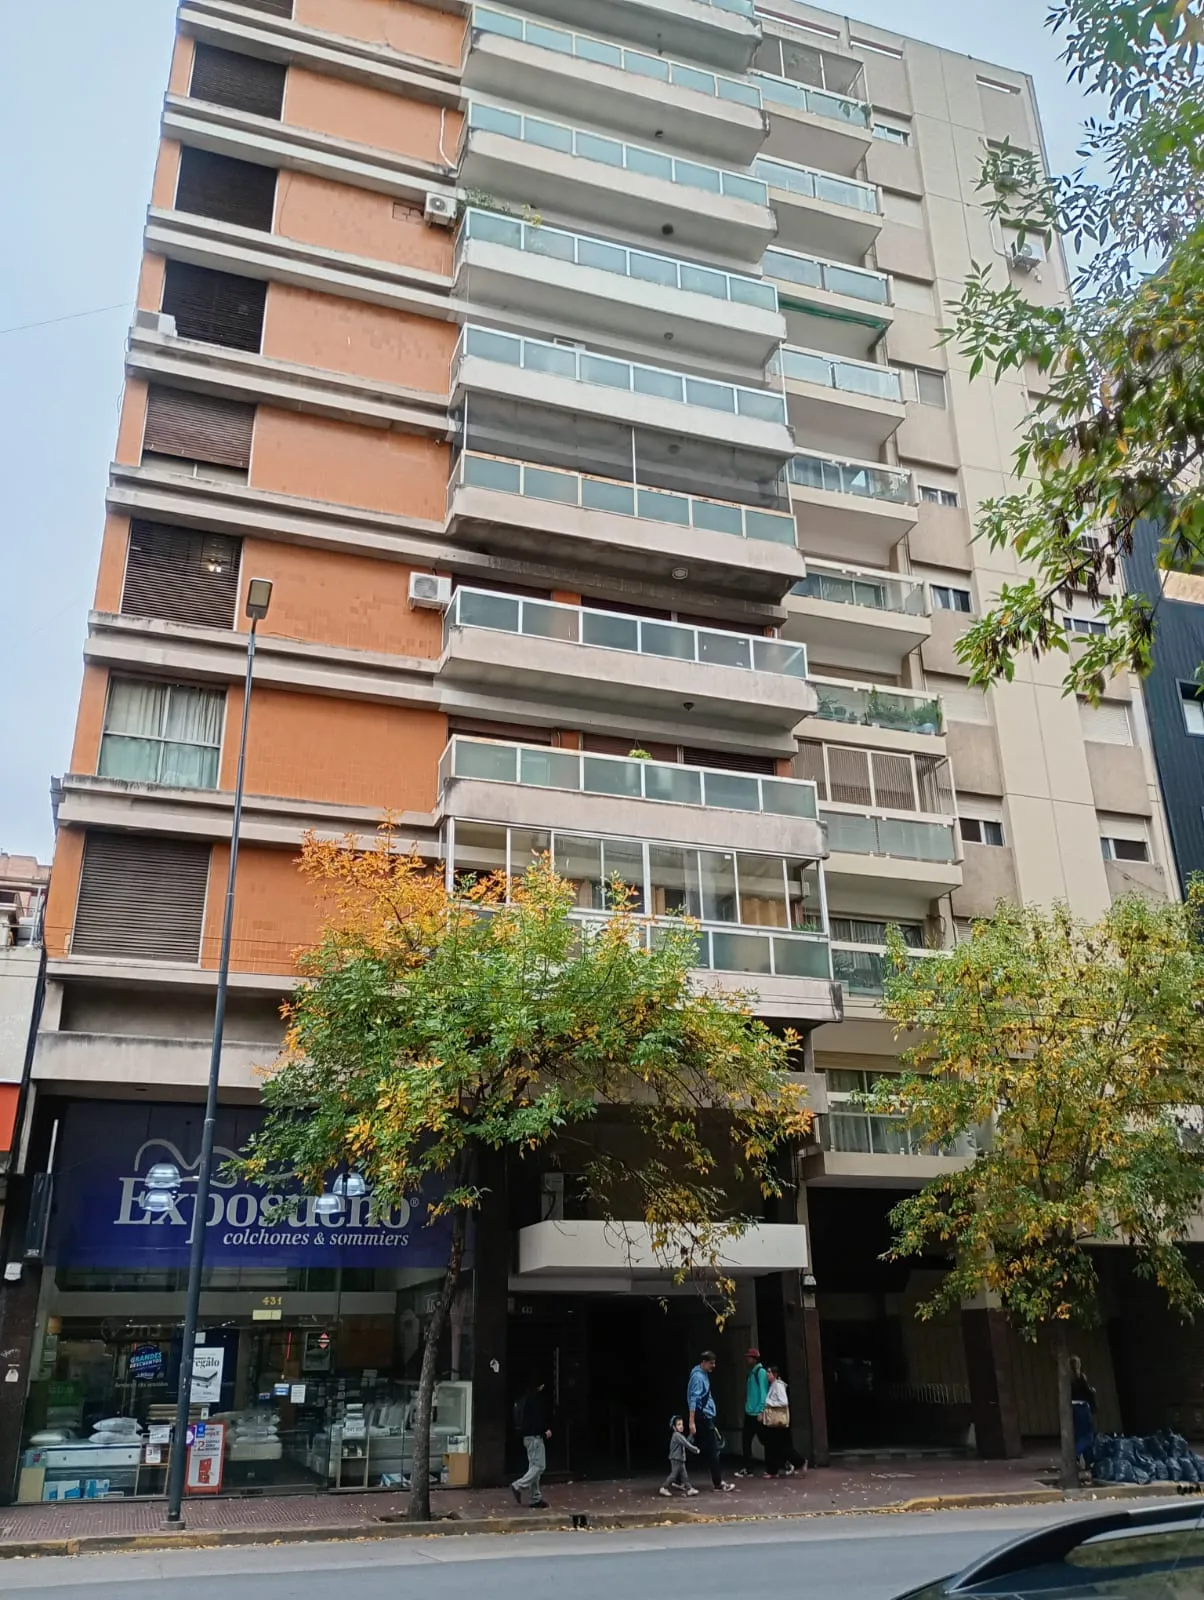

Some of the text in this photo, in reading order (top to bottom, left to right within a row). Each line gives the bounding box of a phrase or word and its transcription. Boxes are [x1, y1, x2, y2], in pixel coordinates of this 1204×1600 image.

[223, 1228, 409, 1246] colchones & sommiers
[262, 1296, 282, 1305] 431
[130, 1352, 162, 1364] GRANDES
